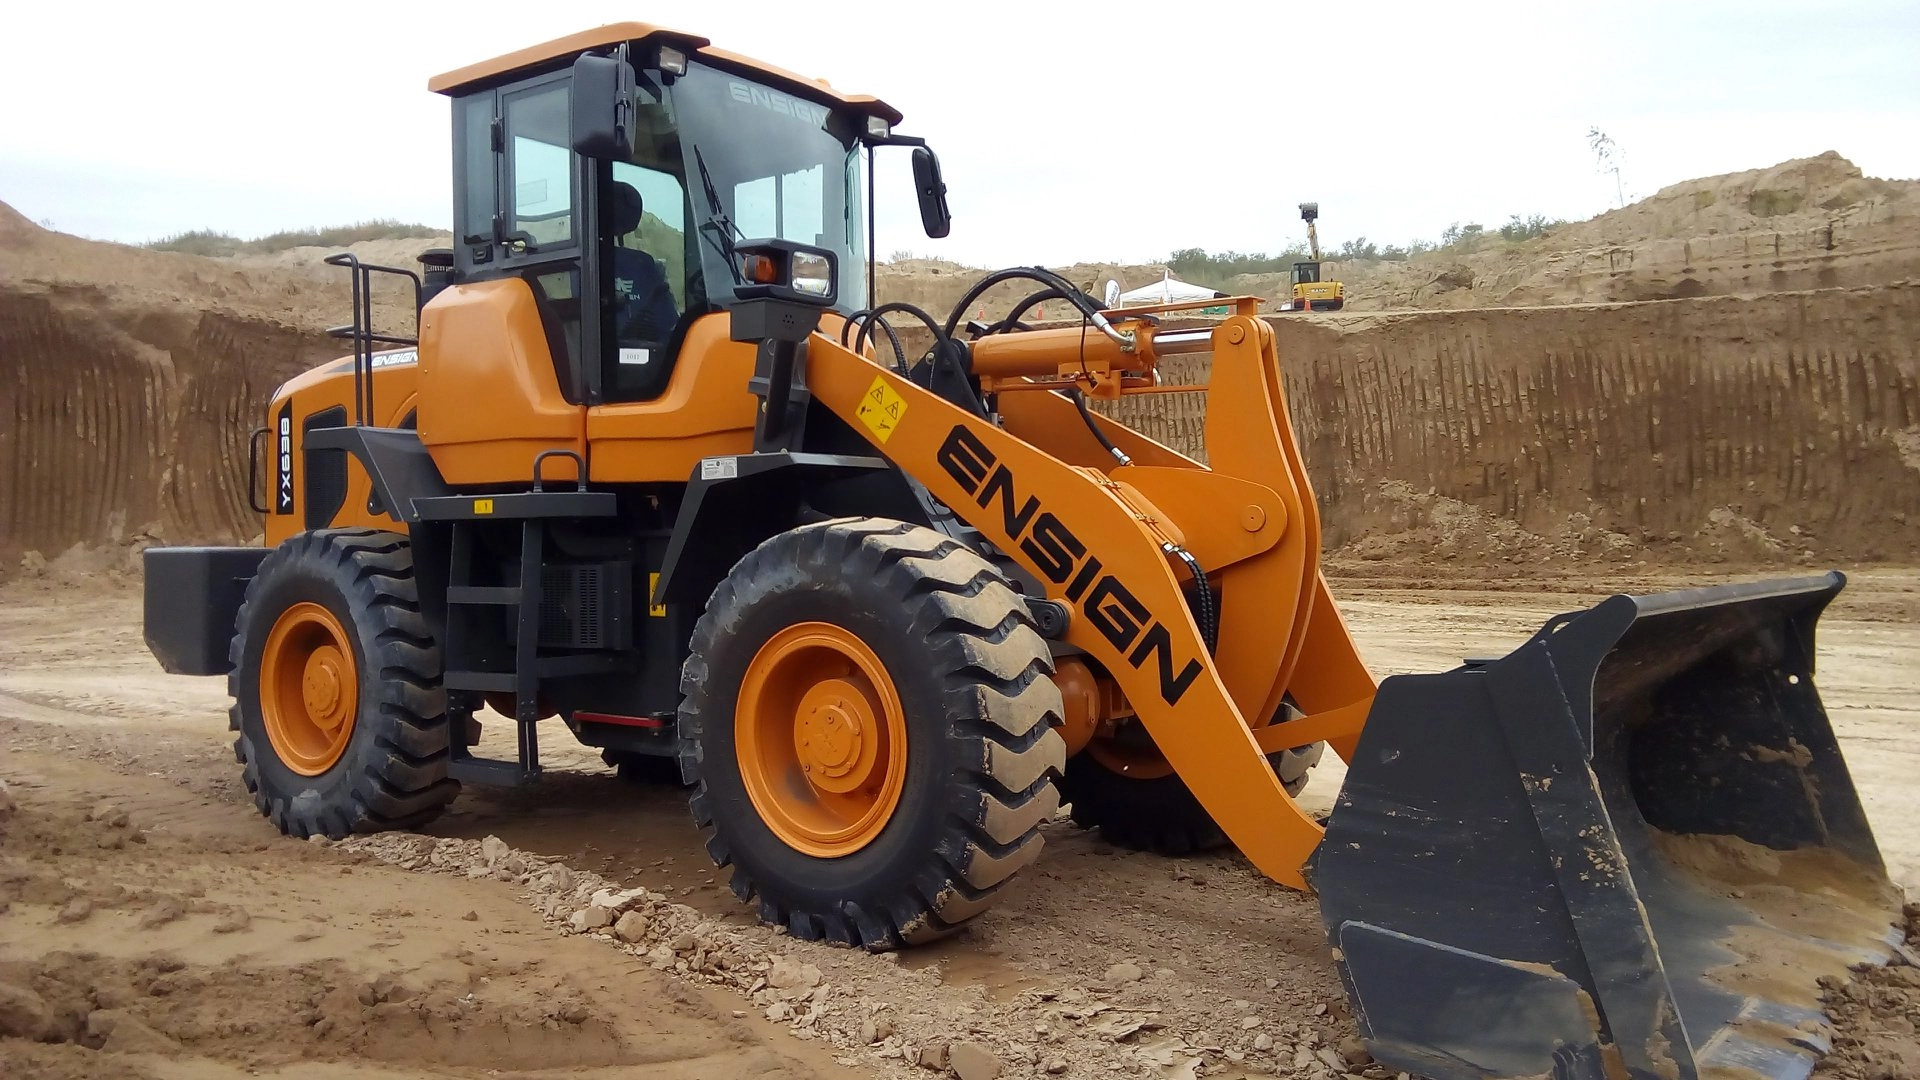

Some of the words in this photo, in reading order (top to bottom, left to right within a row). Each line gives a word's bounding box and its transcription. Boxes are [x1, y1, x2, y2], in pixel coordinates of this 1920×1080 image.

[728, 81, 827, 129] ENSIGN
[371, 351, 418, 367] ENSIGN
[281, 417, 291, 507] YX638
[937, 424, 1204, 707] ENSIGN
